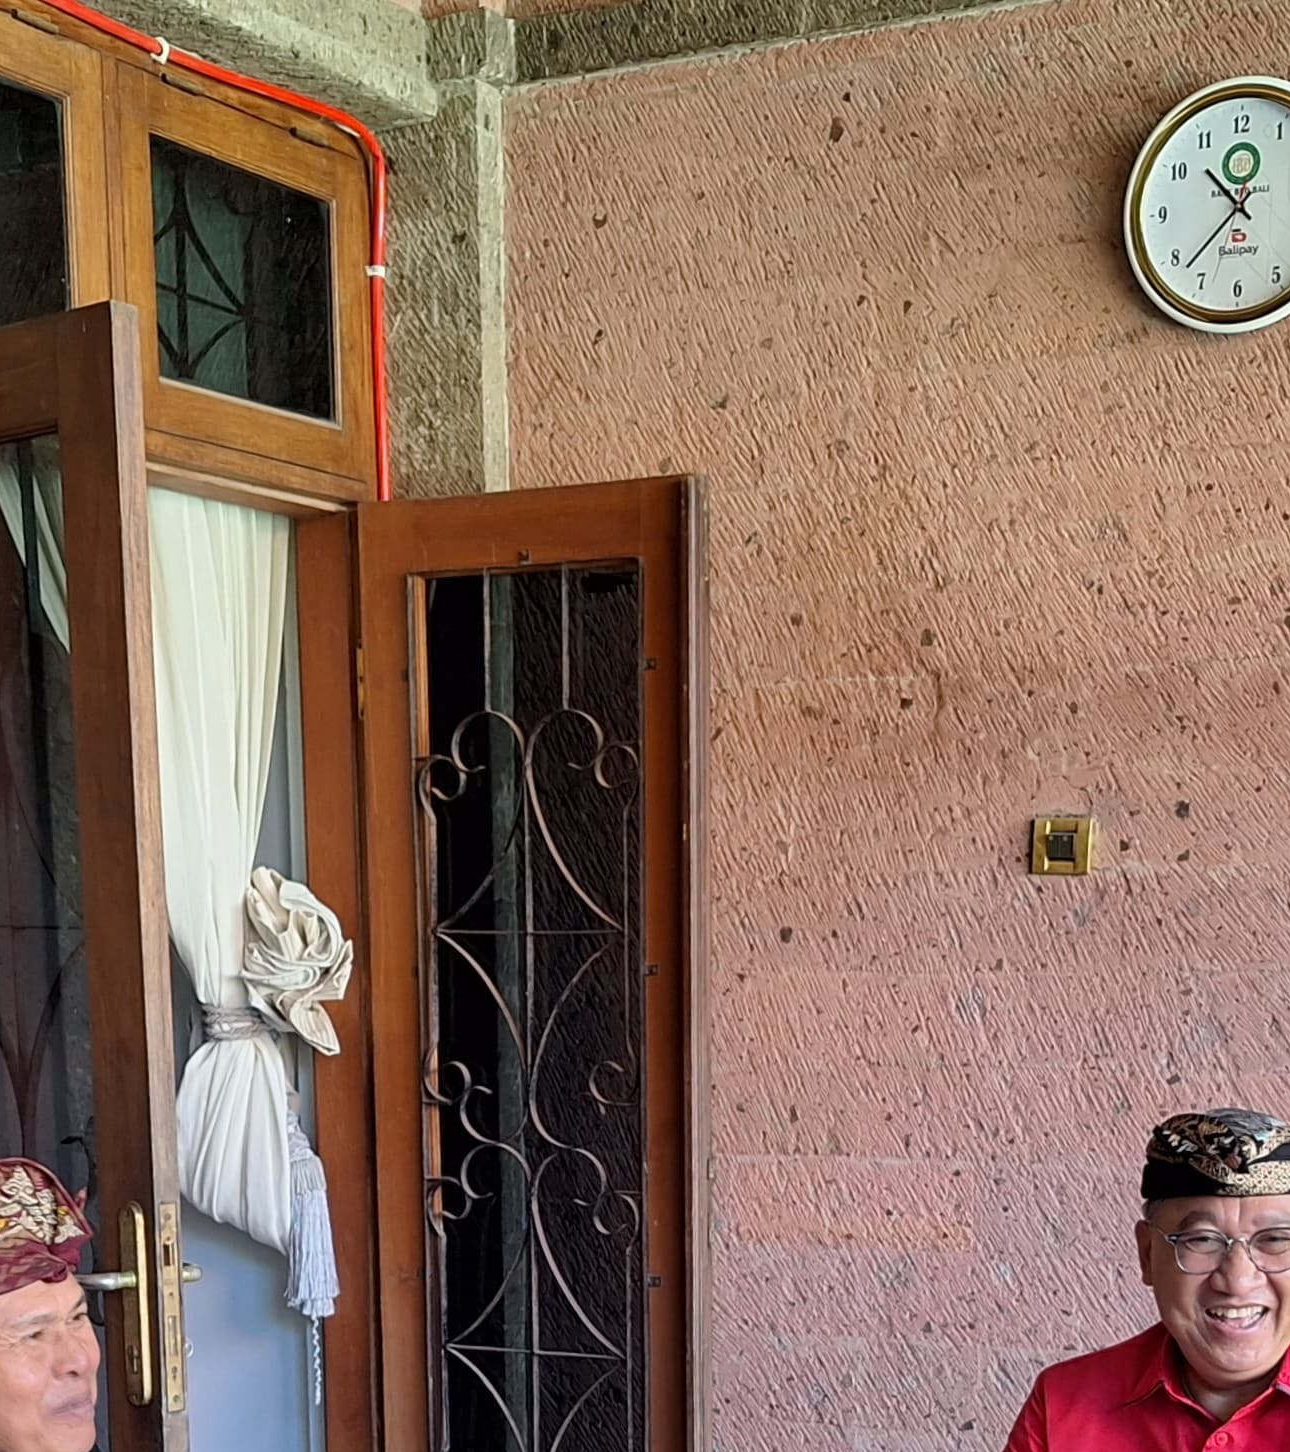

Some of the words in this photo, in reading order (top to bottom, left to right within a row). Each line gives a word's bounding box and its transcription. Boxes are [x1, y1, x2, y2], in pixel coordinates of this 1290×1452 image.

[1233, 114, 1250, 134] 12
[1276, 122, 1283, 140] 1
[1198, 132, 1212, 149] 11
[1171, 162, 1187, 181] 10
[1159, 206, 1167, 224] 9
[1171, 249, 1180, 266] 8
[1219, 245, 1259, 256] Balipay
[1197, 273, 1206, 290] 7
[1271, 266, 1281, 284] 5
[1233, 280, 1242, 298] 6
